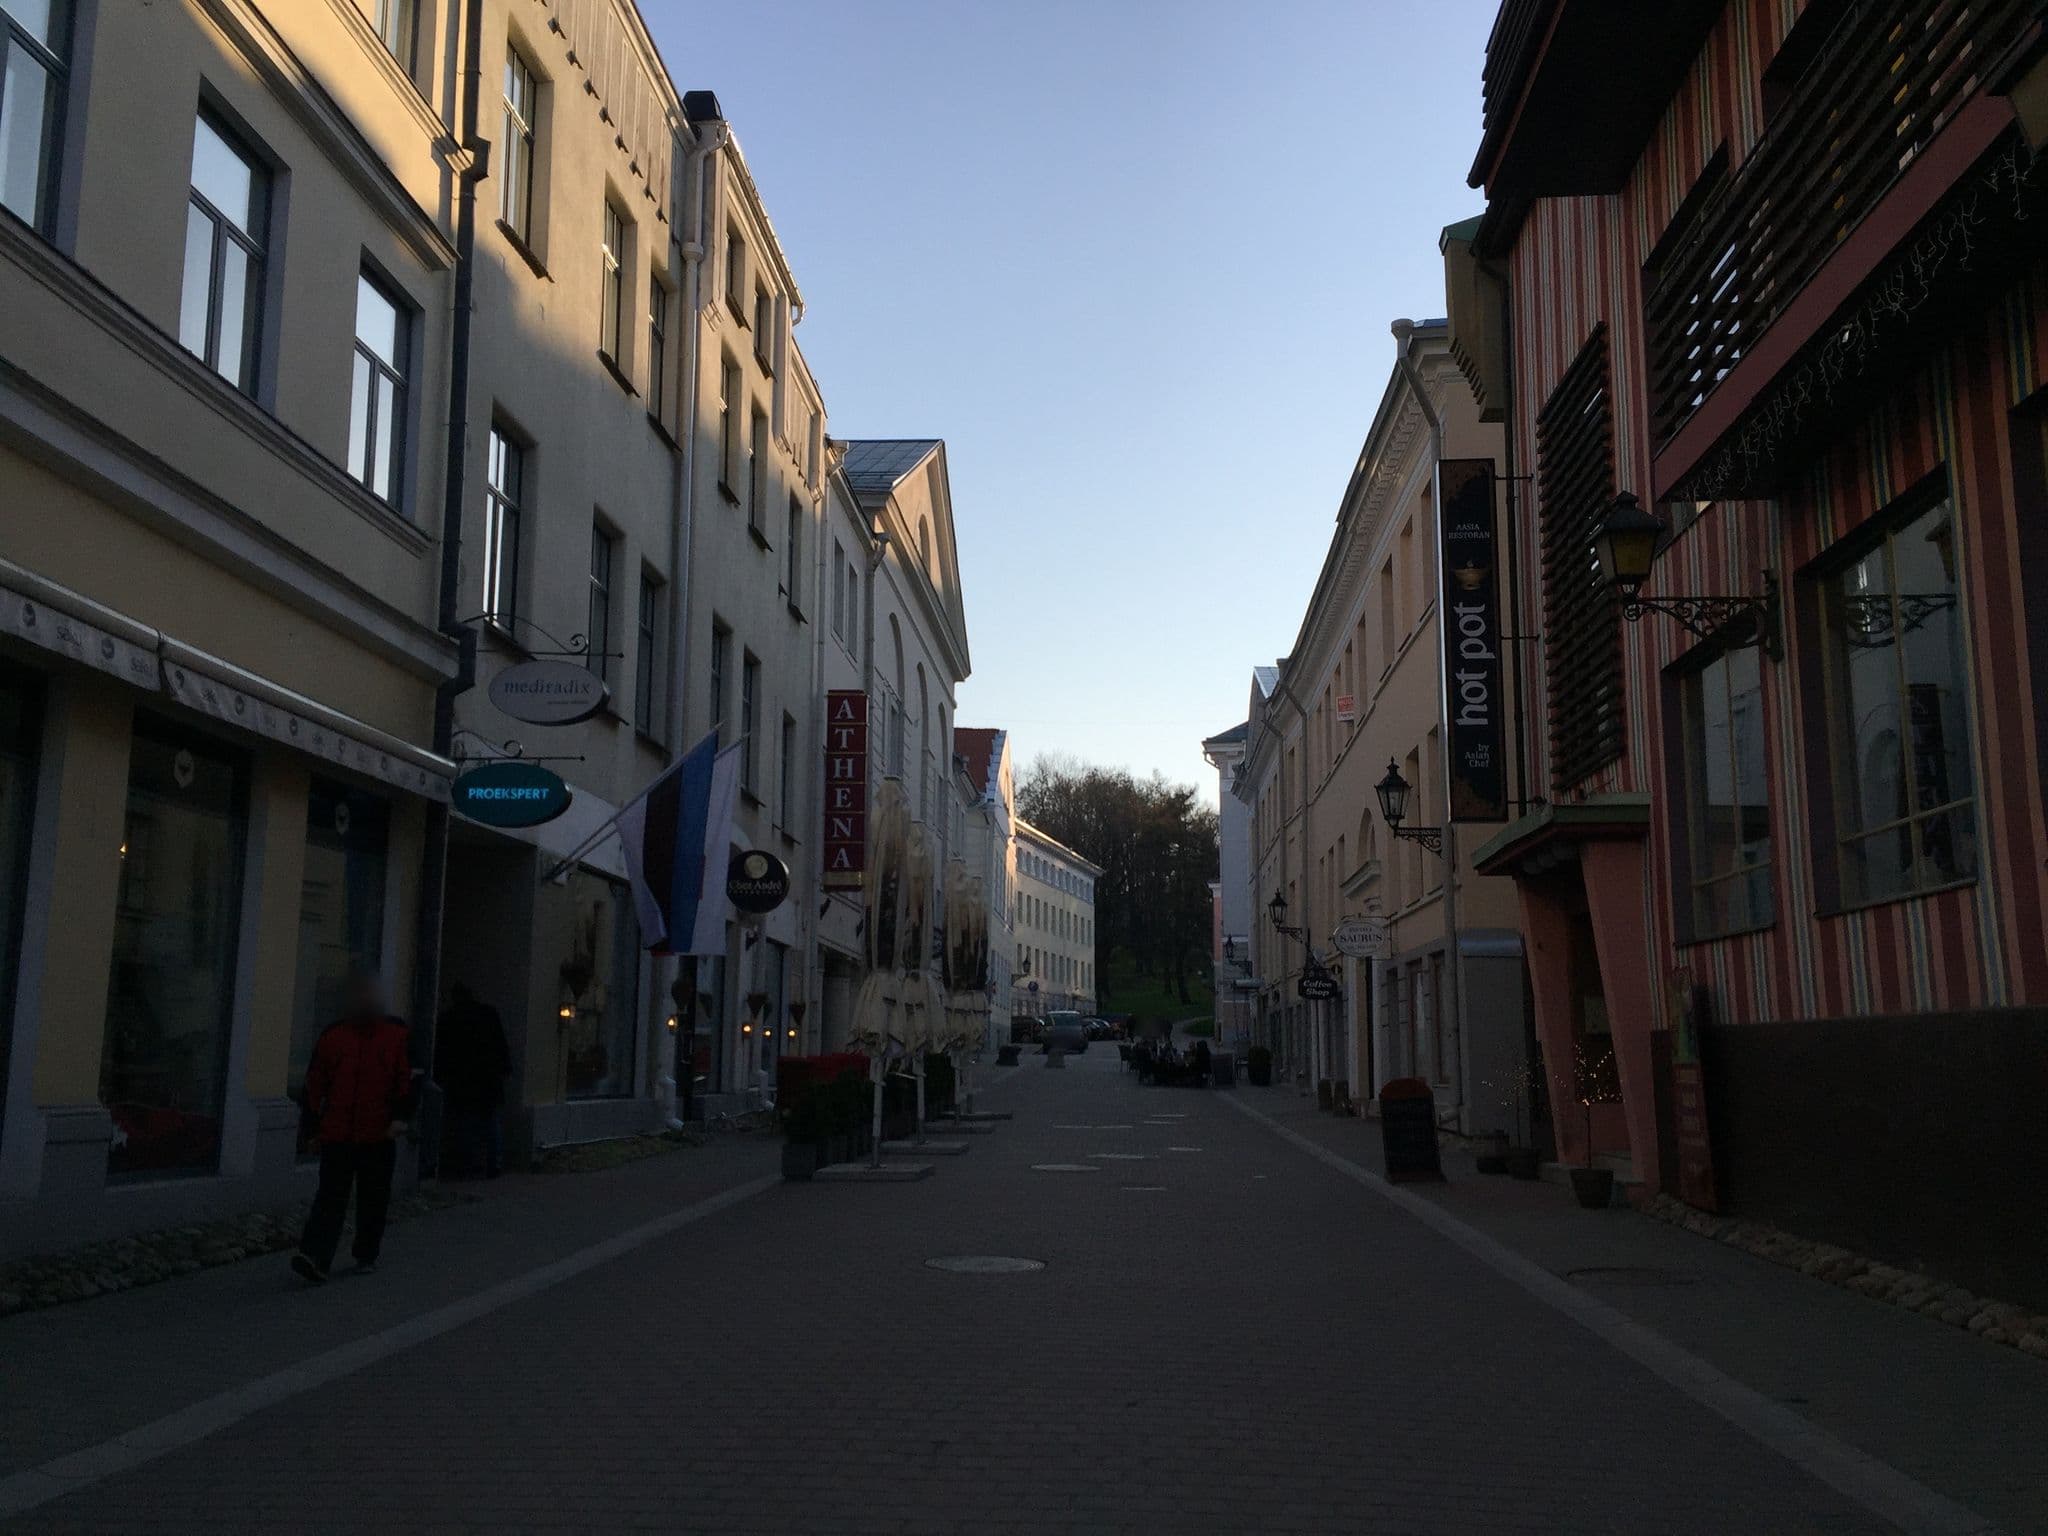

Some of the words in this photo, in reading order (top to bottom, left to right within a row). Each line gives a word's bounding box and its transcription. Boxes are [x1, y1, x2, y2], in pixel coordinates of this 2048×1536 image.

[1455, 522, 1480, 531] AASIA
[1448, 531, 1490, 540] RESTORAN
[1453, 601, 1496, 660] pot
[504, 680, 591, 695] mediradix
[1455, 667, 1489, 727] hot
[1477, 743, 1490, 752] by
[831, 698, 856, 869] ATHENA
[467, 787, 550, 800] PROEKSPERT
[1340, 933, 1383, 943] SAURUS
[1306, 988, 1330, 997] Shop
